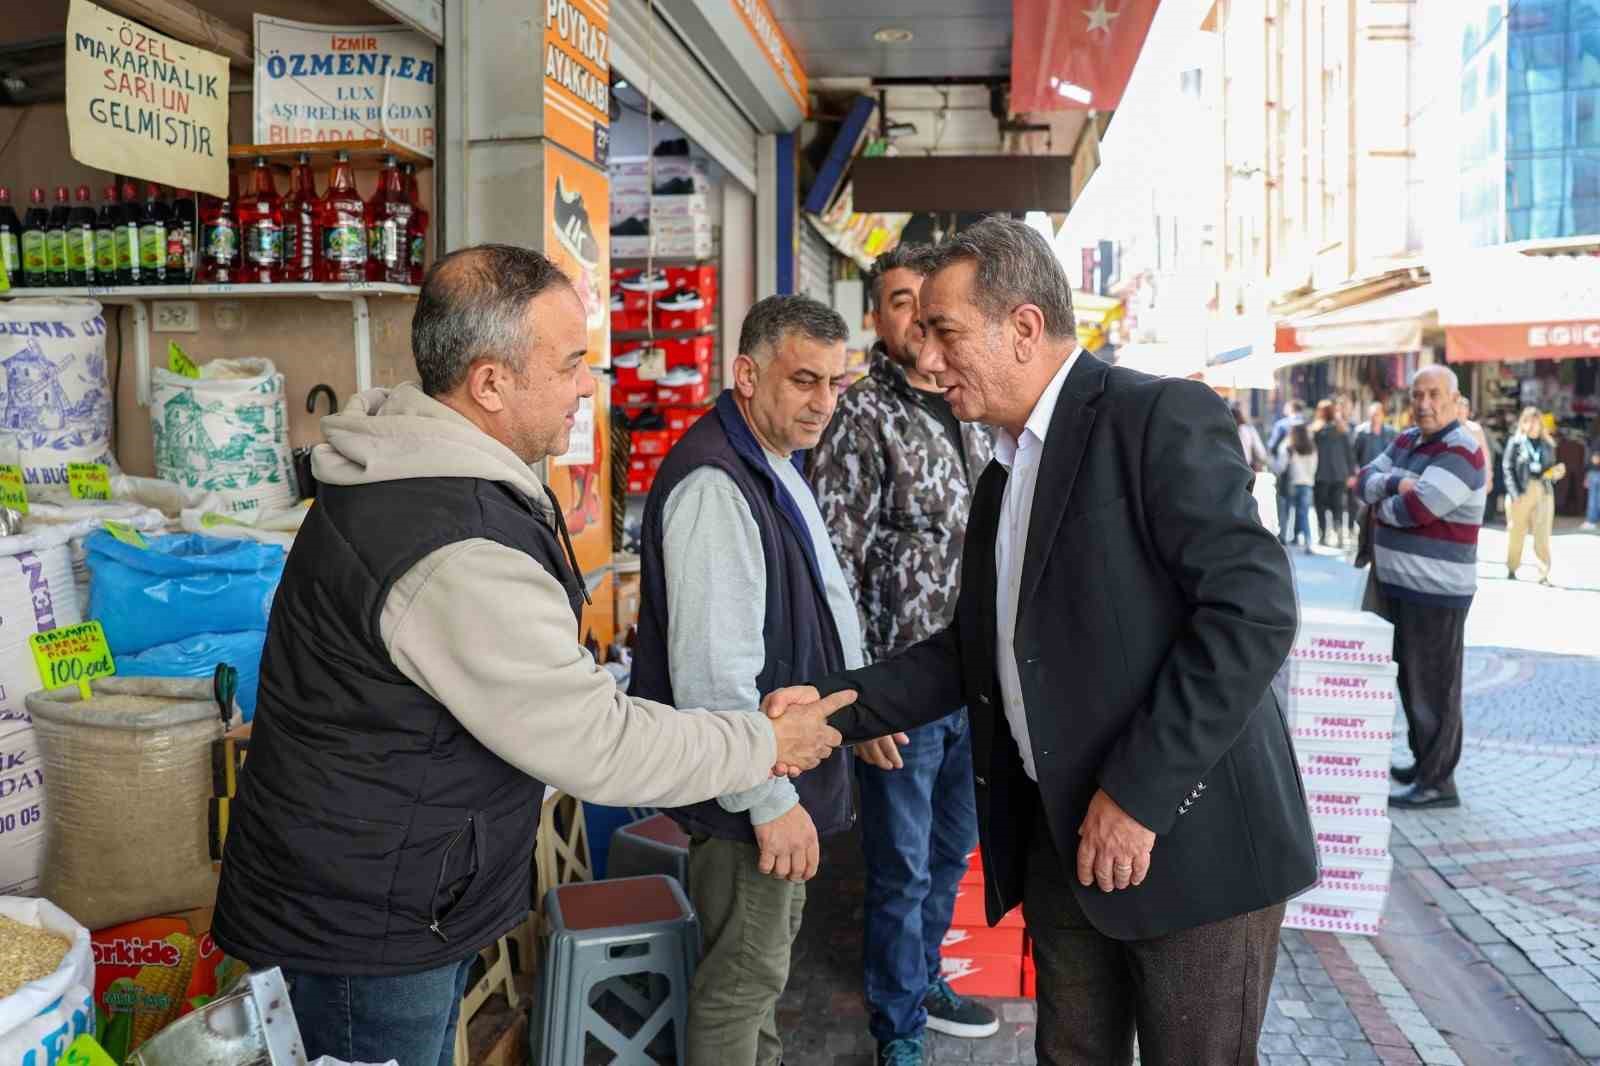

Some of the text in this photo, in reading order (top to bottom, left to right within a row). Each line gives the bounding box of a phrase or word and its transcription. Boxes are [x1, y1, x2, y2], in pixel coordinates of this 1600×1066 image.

[331, 35, 377, 50] İZMİR
[546, 0, 608, 71] POYRAZ
[75, 32, 218, 100] MAKARNALIK
[267, 49, 434, 84] ÖZMENLER
[545, 43, 608, 115] AYAKKABI
[104, 69, 190, 114] SARI UN
[337, 87, 375, 100] LUX
[41, 463, 69, 484] BUĞ
[20, 804, 41, 827] 05
